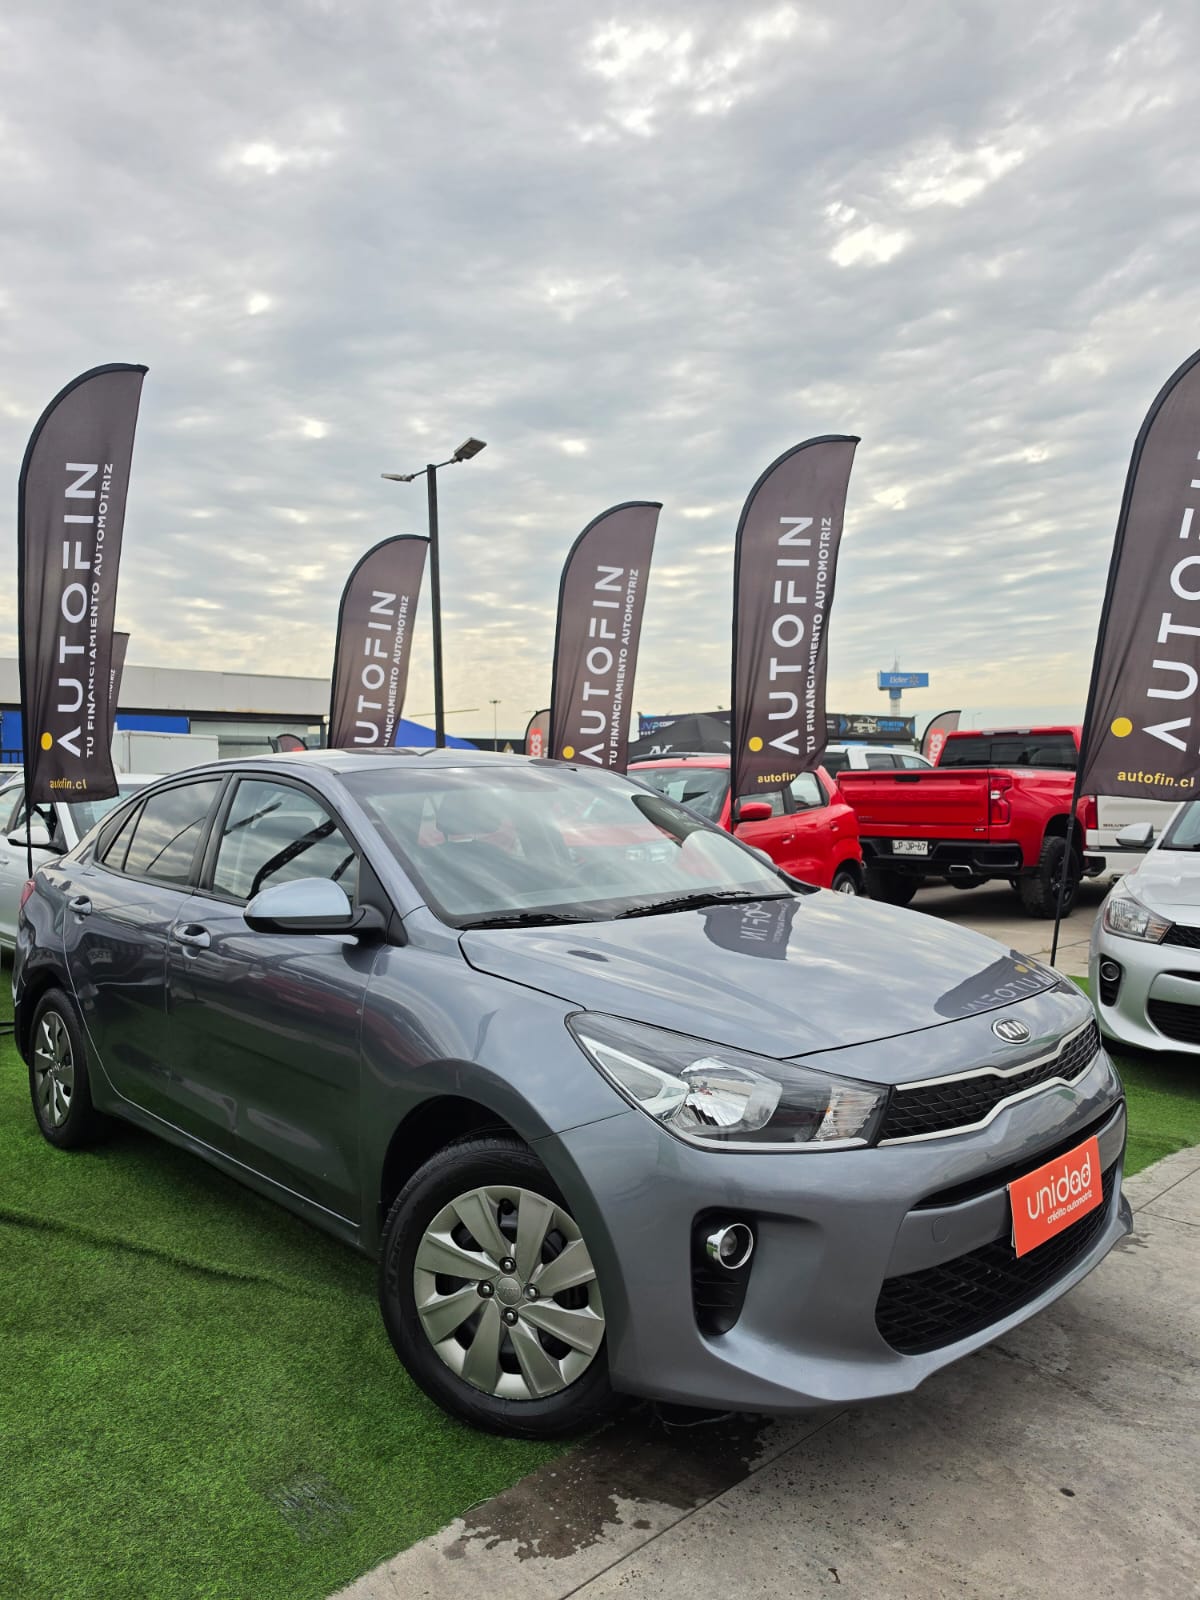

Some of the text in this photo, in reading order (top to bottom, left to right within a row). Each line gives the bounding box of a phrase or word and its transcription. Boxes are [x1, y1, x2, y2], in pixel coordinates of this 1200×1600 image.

[57, 463, 99, 758] AUTOFIN
[87, 464, 113, 758] TU FINANCIAMIENTO AUTOMOTRIZ
[354, 590, 397, 745] UTOFIN
[393, 595, 409, 665] AUTOMOTRIZ
[579, 565, 624, 764] AUTOFIN
[609, 568, 639, 765] TU FINANCIAMIENTO AUTOMOTRIZ
[768, 516, 813, 756] AUTOFIN
[806, 517, 832, 753] TU FINANCIAMIENTO AUTOMOTRIZ
[1142, 450, 1200, 752] AUTO
[1117, 771, 1195, 788] autofin.cl
[998, 1019, 1030, 1040] KIA
[1027, 1151, 1092, 1220] unidad
